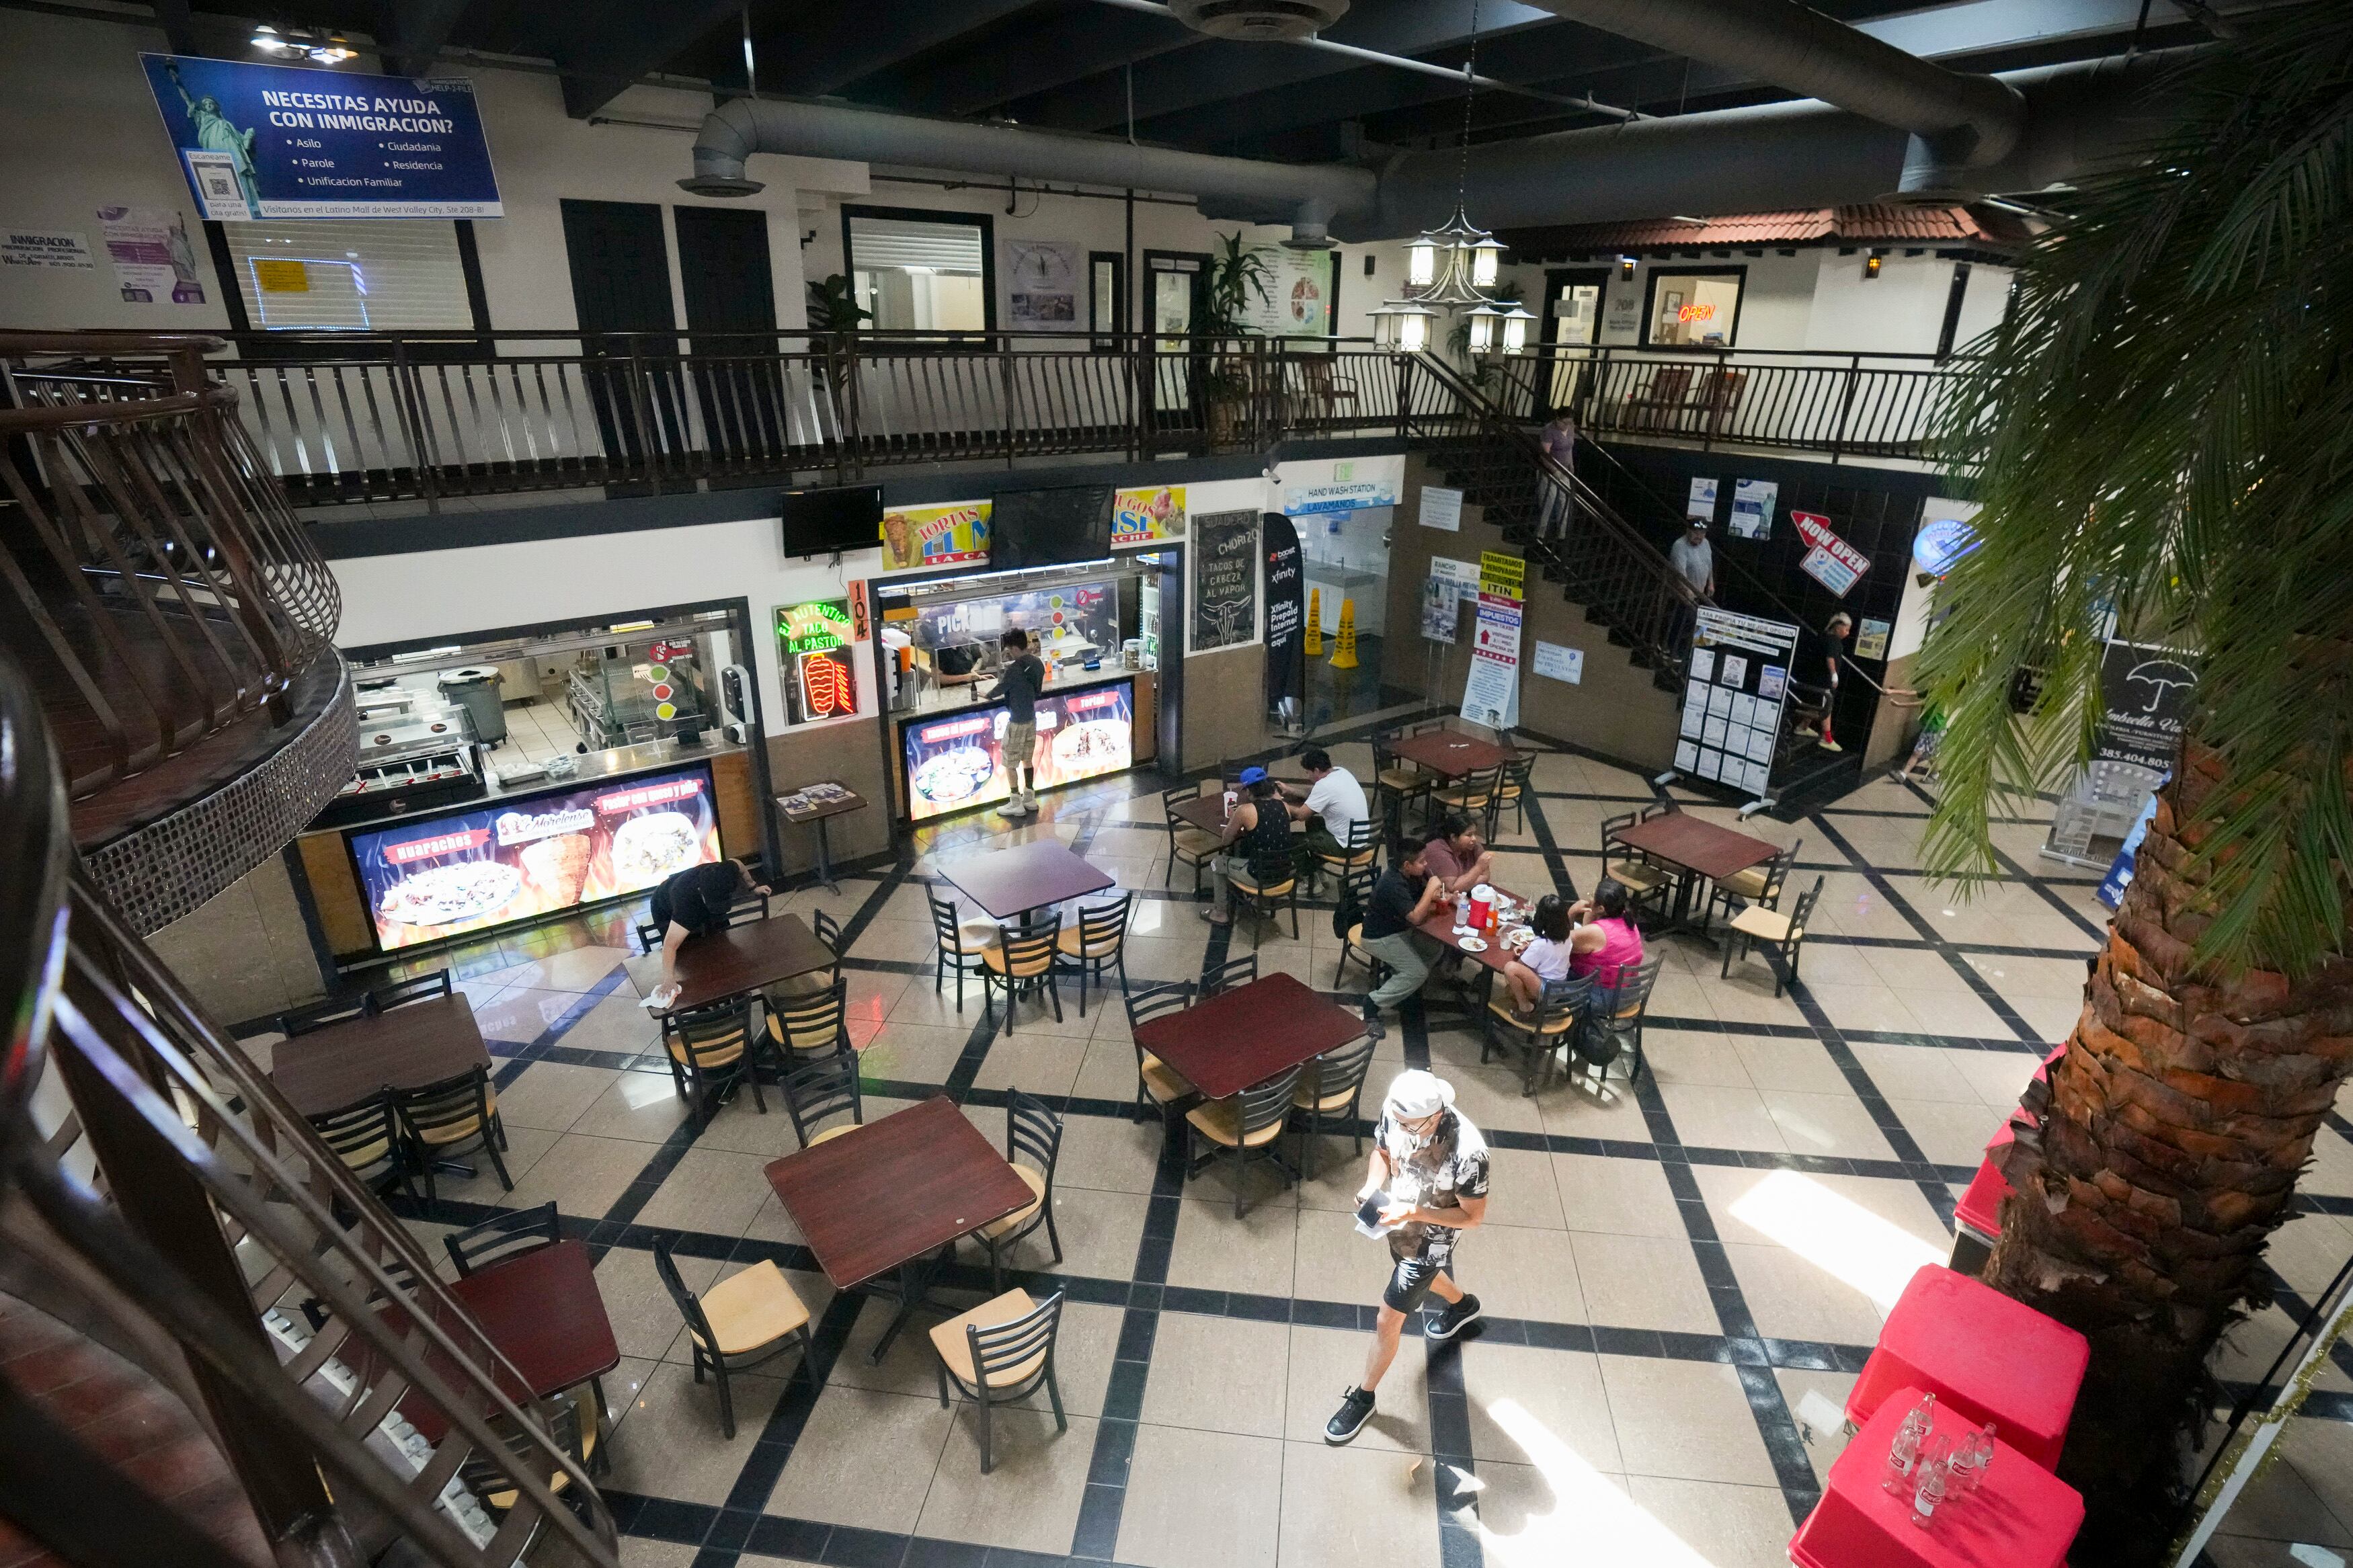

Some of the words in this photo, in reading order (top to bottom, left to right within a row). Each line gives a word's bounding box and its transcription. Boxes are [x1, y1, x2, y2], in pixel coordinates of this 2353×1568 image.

[262, 90, 369, 112] NECESITAS
[374, 97, 441, 115] AYUDA
[269, 111, 315, 128] CON
[317, 114, 453, 134] INMIGRACION?
[296, 138, 321, 149] Asilo
[387, 142, 442, 152] Ciudadania
[301, 159, 335, 169] Parole
[393, 161, 443, 171] Residencia
[307, 177, 362, 187] Unificacion
[364, 178, 403, 188] Familiar
[263, 205, 303, 214] Visitanos
[315, 206, 323, 214] el
[325, 206, 351, 214] Latino
[352, 206, 370, 214] Mall
[372, 206, 381, 214] de
[403, 206, 427, 214] Valley
[9, 235, 75, 247] INMIGRACION
[1679, 304, 1716, 323] OPEN
[1308, 488, 1327, 498] HAND
[1328, 486, 1349, 496] WASH
[1350, 484, 1376, 494] STATION
[1307, 499, 1356, 512] LAVAMANOS
[915, 507, 979, 541] TORTAS
[1204, 513, 1250, 528] SUADERO
[923, 532, 962, 557] EL
[1218, 527, 1259, 555] CHORIZO
[1800, 516, 1836, 547] NOW
[1831, 540, 1868, 573] OPEN
[932, 555, 953, 564] LA
[1277, 546, 1296, 558] boost
[1208, 561, 1234, 573] TACOS
[1235, 559, 1245, 569] DE
[1434, 561, 1457, 571] RANCHO
[1482, 553, 1523, 569] TRAMITAMOS
[1210, 573, 1242, 586] CABEZA
[1271, 567, 1296, 584] xfinity
[1206, 588, 1216, 598] AL
[1219, 584, 1246, 596] VAPOR
[1487, 583, 1513, 597] ITIN
[792, 604, 851, 629] AUTENTICO
[854, 582, 868, 638] 104
[1271, 606, 1298, 624] Prepaid
[1479, 610, 1519, 625] IMPUESTOS
[779, 621, 795, 637] EL
[801, 621, 829, 635] TACO
[1271, 616, 1298, 632] Internet
[1698, 610, 1714, 619] CASA
[1714, 613, 1737, 625] PROPIA
[1769, 626, 1794, 637] OPCION
[789, 641, 802, 653] AL
[804, 634, 844, 650] PASTOR
[1080, 696, 1105, 708] Tortas
[926, 726, 949, 739] Tacos
[2100, 747, 2173, 768] 385.404.805
[631, 792, 648, 805] con
[525, 811, 589, 832] Morelense
[397, 833, 473, 860] Huaraches
